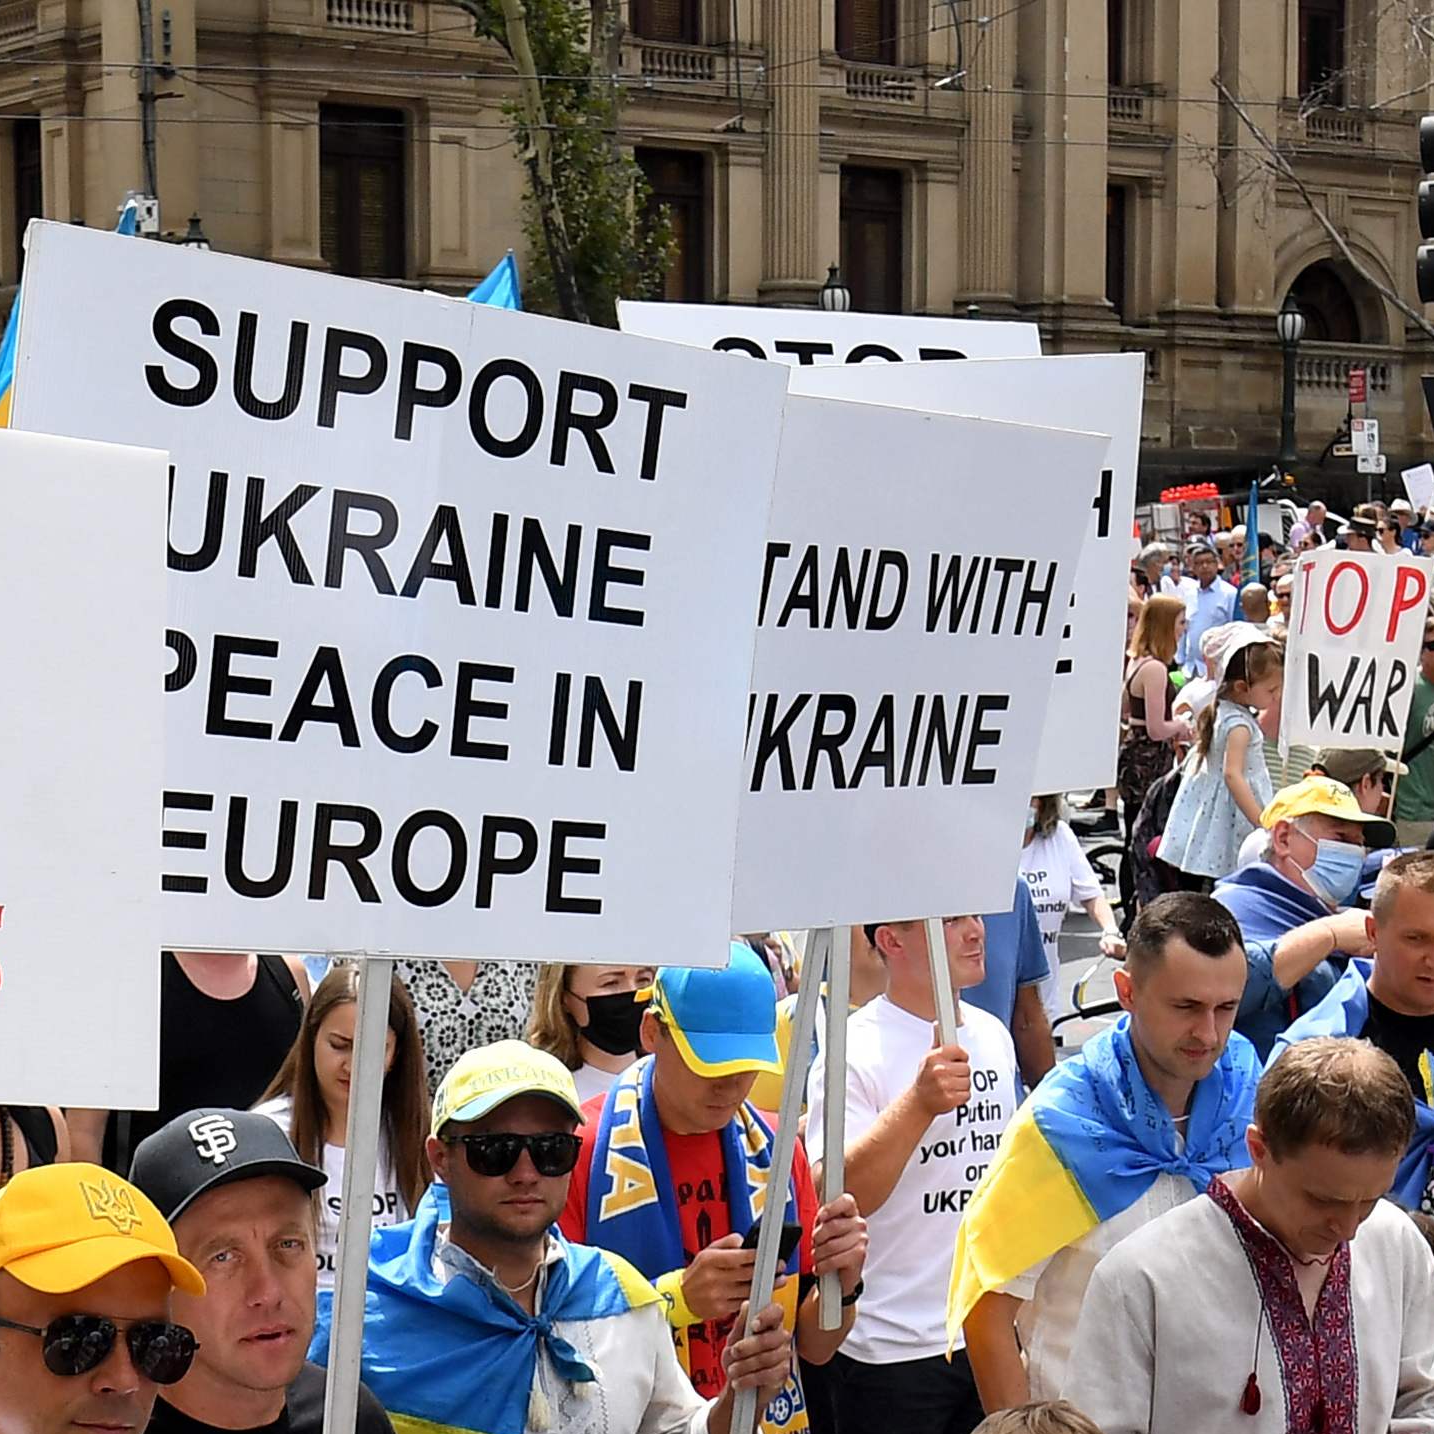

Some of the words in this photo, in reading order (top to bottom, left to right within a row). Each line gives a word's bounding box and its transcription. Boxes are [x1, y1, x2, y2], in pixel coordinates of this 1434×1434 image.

[143, 298, 688, 482] SUPPORT
[167, 464, 652, 628] UKRAINE
[925, 552, 1059, 637] WITH
[547, 671, 643, 774] IN
[744, 693, 1010, 792] KRAINE
[1307, 652, 1407, 738] WAR
[162, 789, 607, 915] EUROPE
[955, 1098, 1001, 1127] Putin
